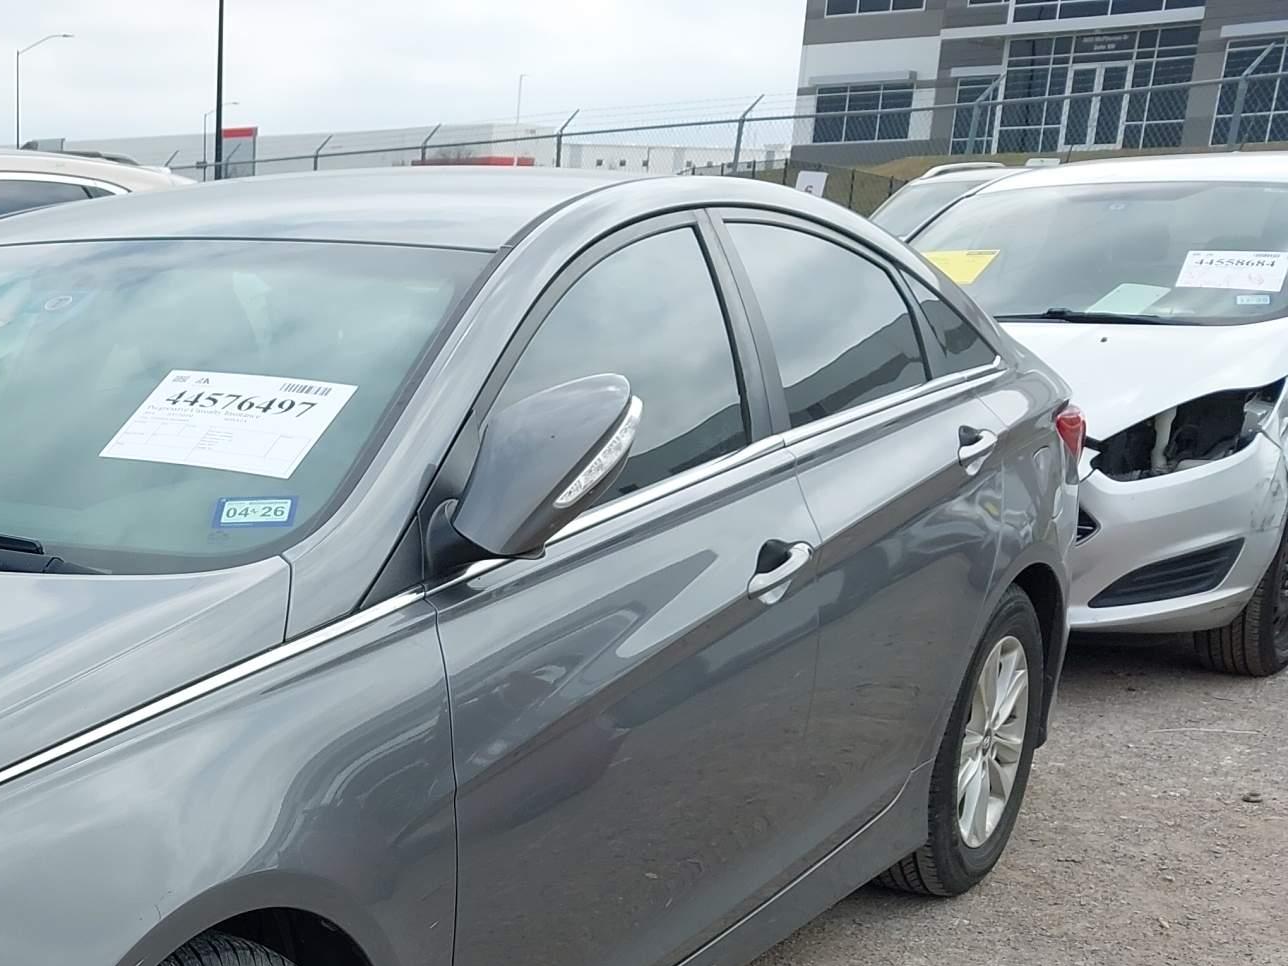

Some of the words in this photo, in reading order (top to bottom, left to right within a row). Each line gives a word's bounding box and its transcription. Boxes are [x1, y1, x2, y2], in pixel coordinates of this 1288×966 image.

[1194, 258, 1276, 268] 44558684
[165, 390, 318, 418] 44576497
[225, 507, 250, 519] 04
[260, 506, 286, 517] 26
